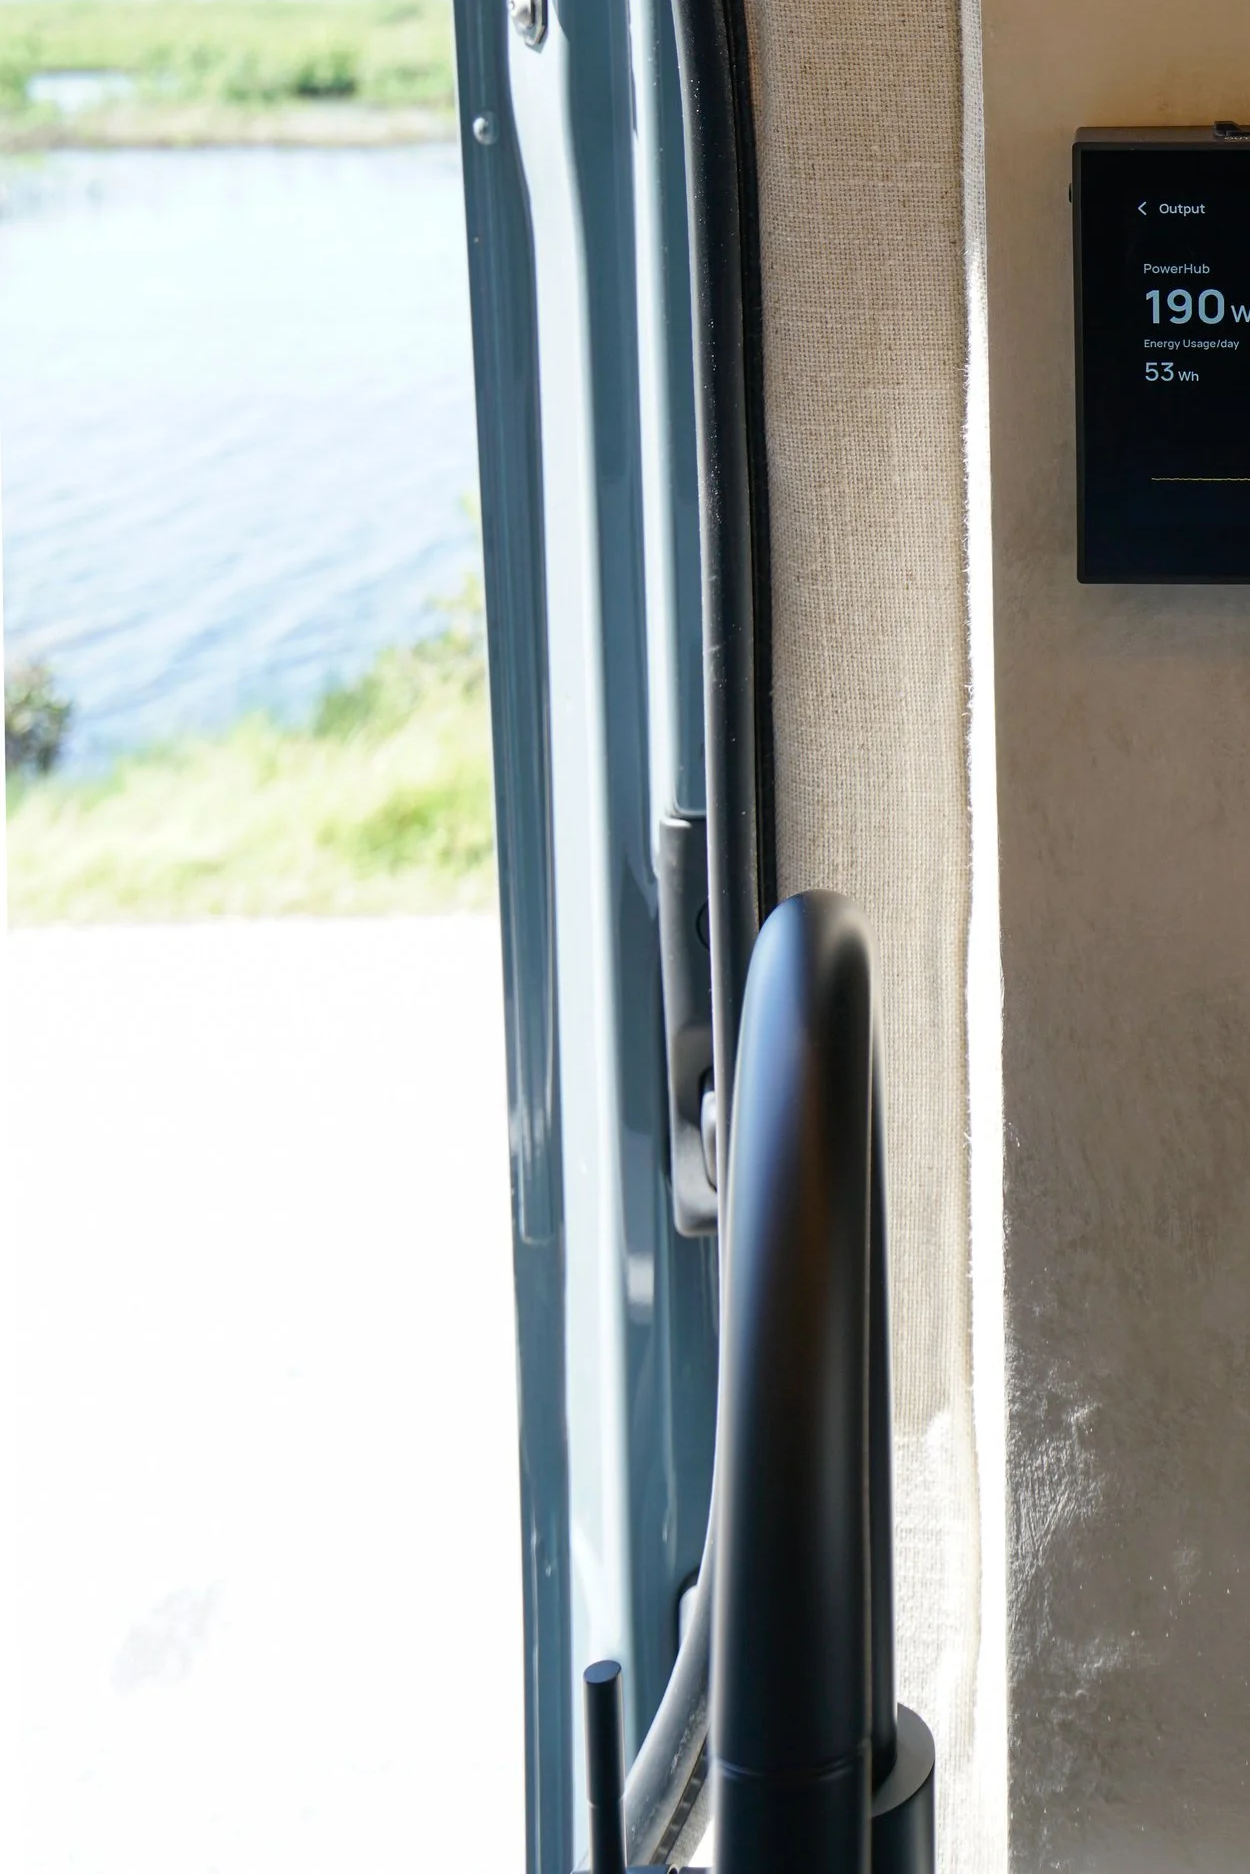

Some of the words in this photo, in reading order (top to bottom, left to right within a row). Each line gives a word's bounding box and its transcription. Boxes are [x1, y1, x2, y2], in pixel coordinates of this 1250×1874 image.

[1159, 204, 1205, 216] Output
[1144, 264, 1210, 274] PowerHub
[1146, 289, 1224, 324] 190
[1144, 339, 1180, 350] Energy
[1183, 340, 1239, 350] Usage/day
[1146, 362, 1174, 381] 53
[1178, 371, 1199, 381] Wh
